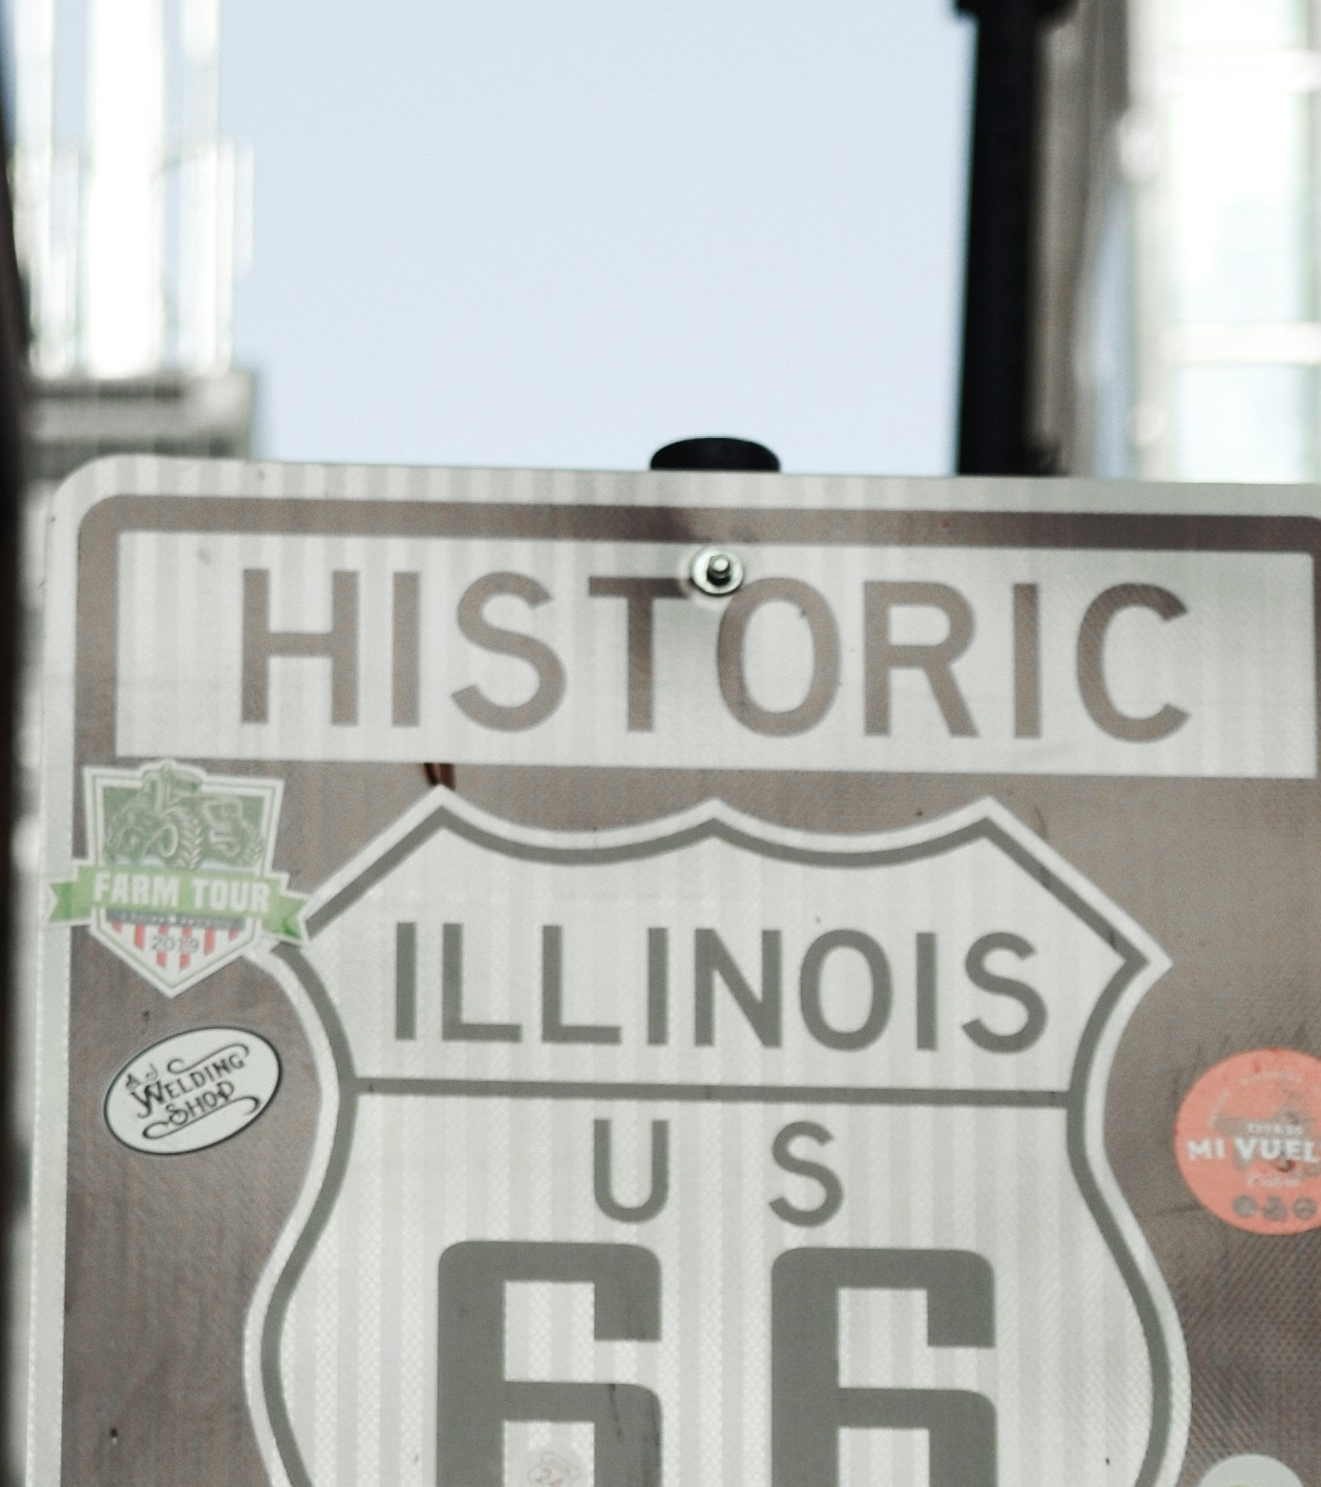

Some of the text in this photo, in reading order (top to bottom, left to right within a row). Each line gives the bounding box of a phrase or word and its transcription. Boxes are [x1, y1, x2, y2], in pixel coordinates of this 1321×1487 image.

[238, 566, 1192, 744] HISTORIC
[94, 872, 271, 913] FARM TOUR
[394, 921, 1048, 1054] ILLINOIS
[592, 1118, 844, 1227] U S
[1187, 1138, 1226, 1161] MI
